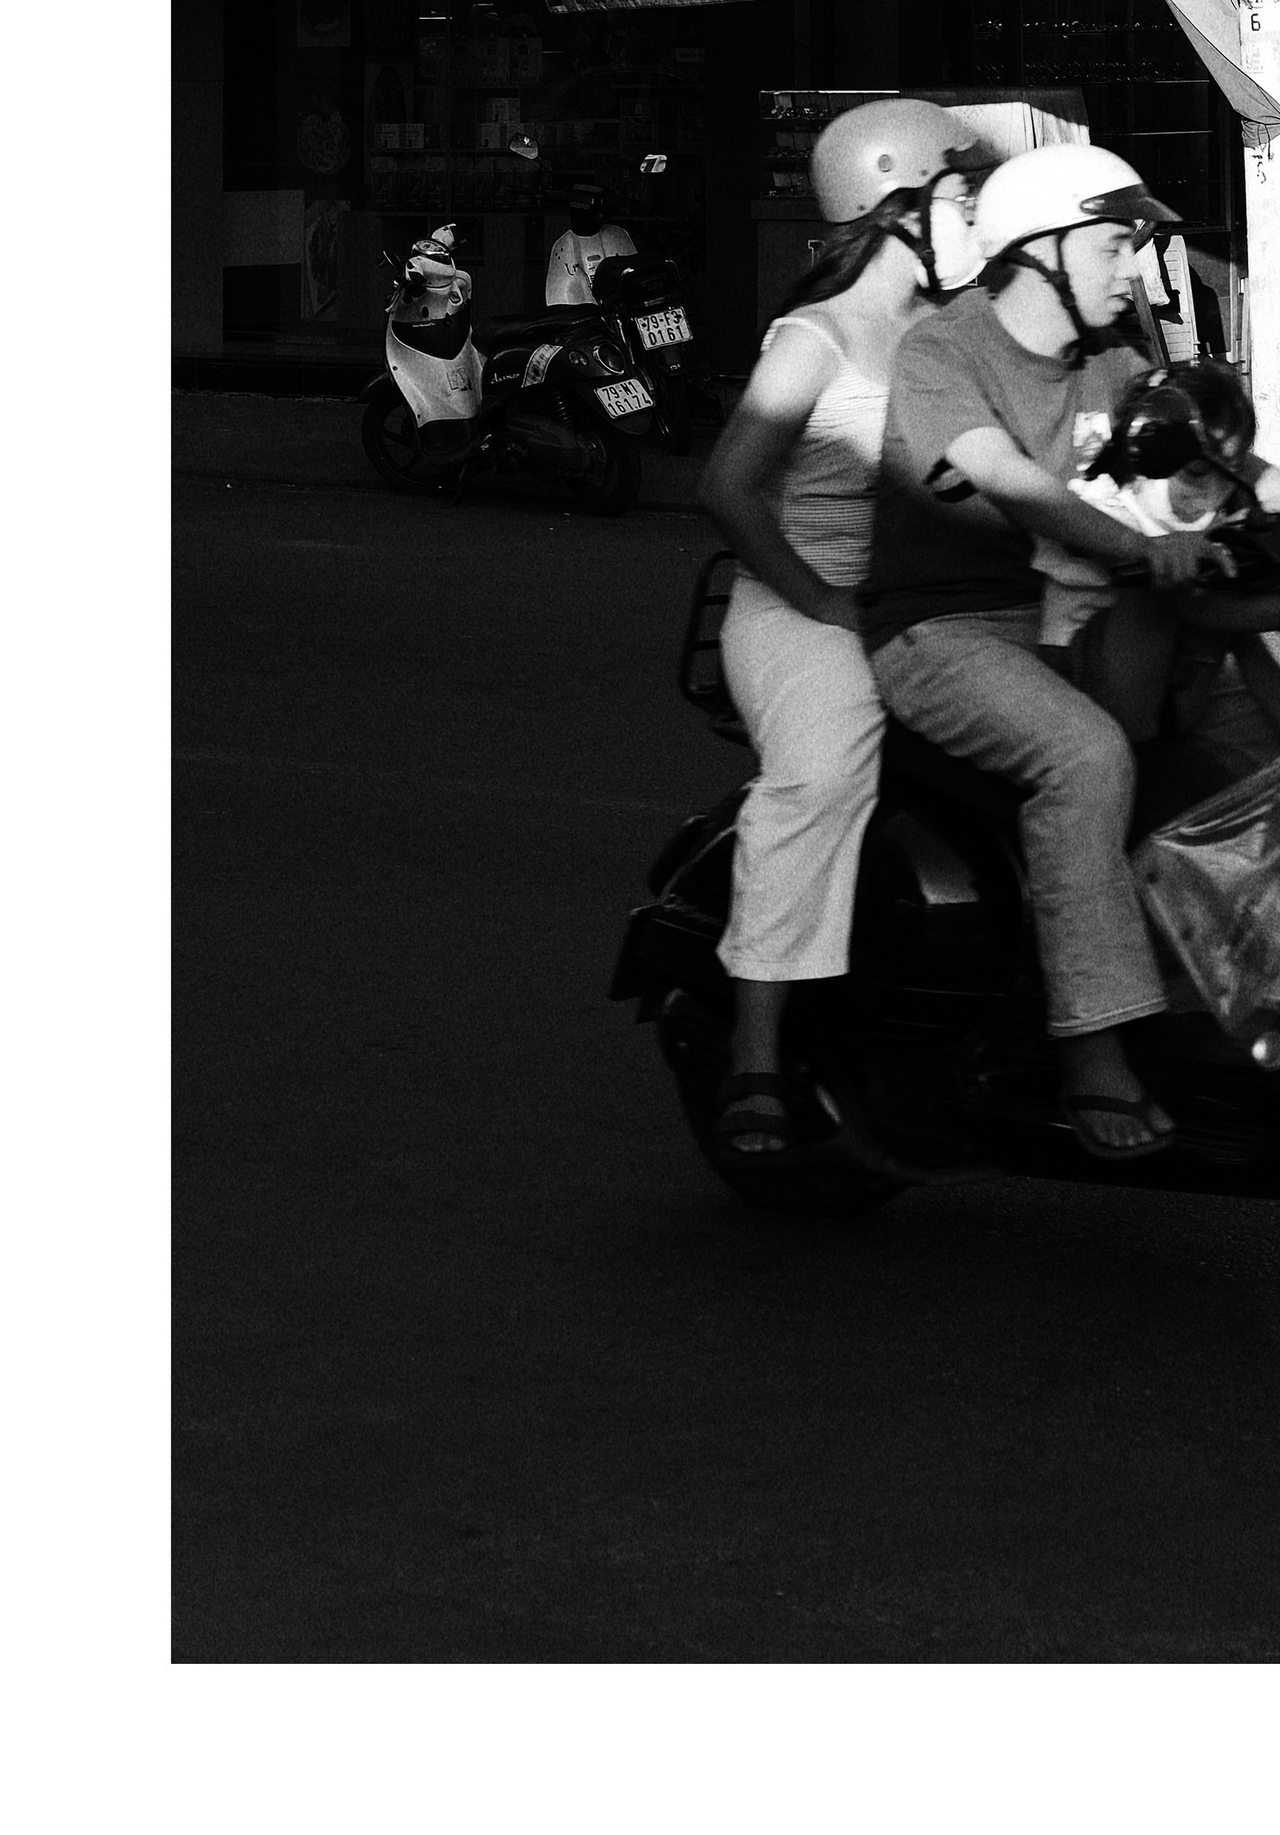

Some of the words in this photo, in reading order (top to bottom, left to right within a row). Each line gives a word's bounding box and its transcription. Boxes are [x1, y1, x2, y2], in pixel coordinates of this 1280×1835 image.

[1251, 13, 1260, 31] 6
[643, 311, 681, 331] 79-F3
[648, 325, 683, 345] 0161
[608, 393, 651, 414] 161.74
